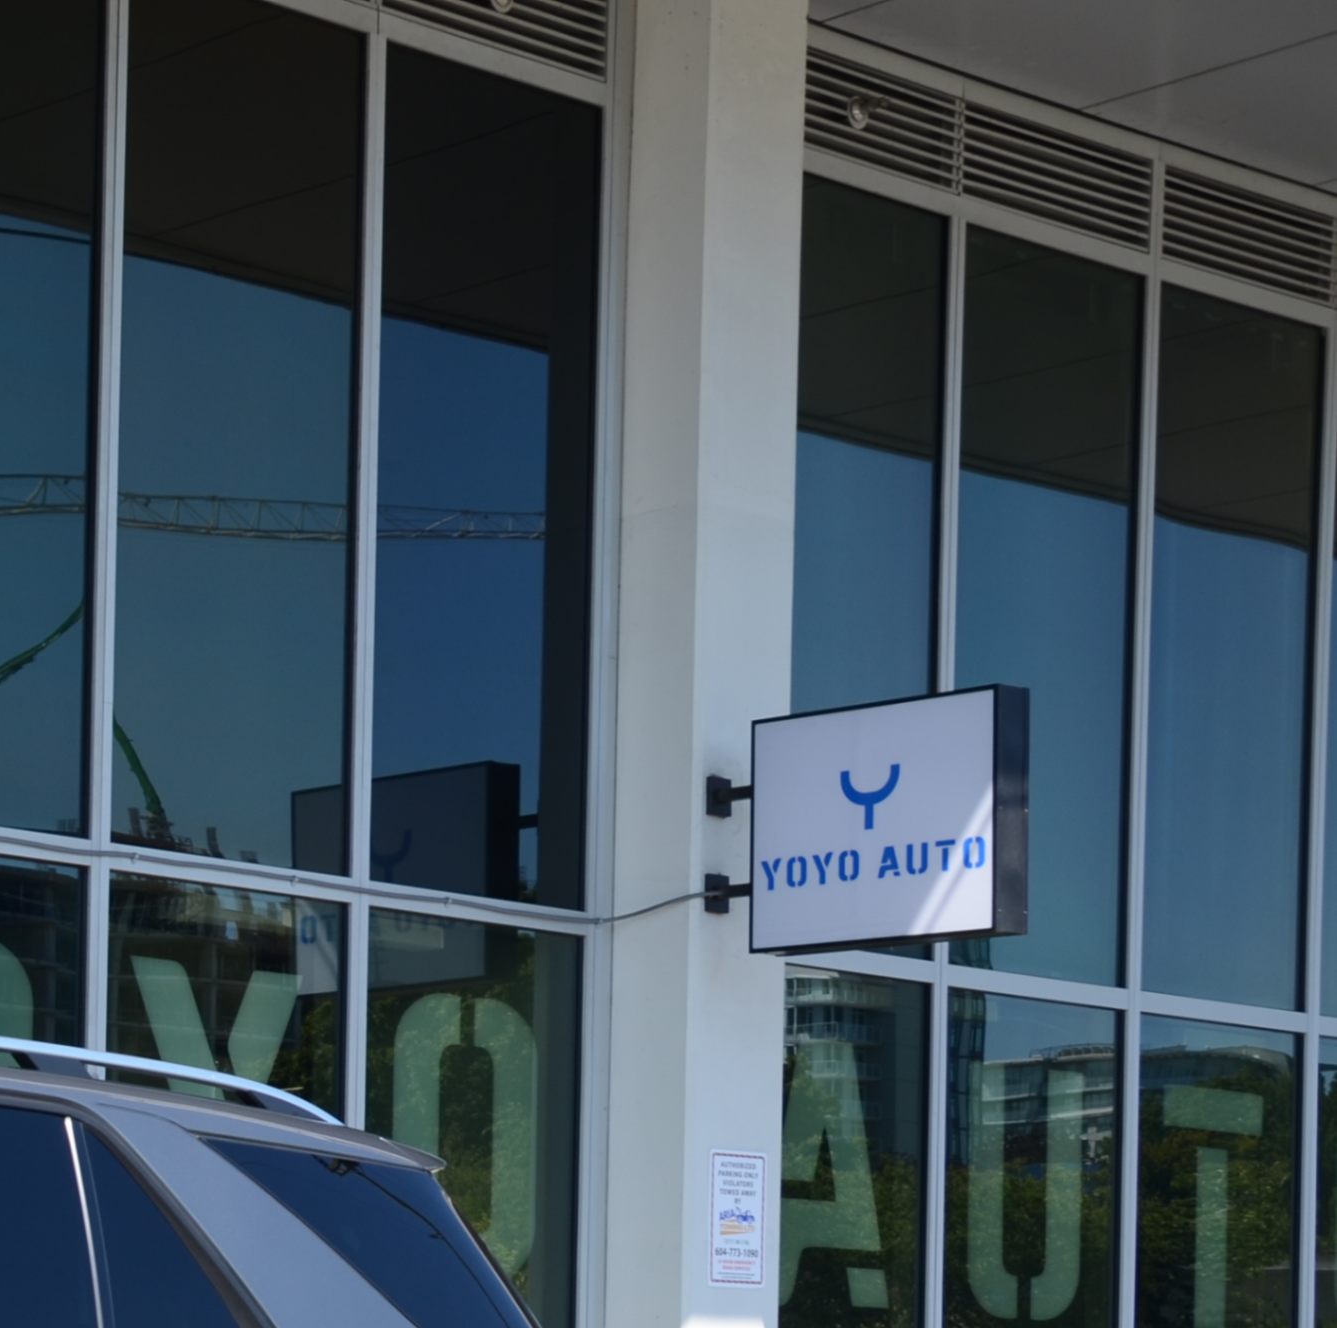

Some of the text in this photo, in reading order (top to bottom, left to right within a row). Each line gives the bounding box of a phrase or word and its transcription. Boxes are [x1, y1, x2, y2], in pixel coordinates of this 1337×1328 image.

[761, 836, 986, 891] YOYO AUTO
[718, 1170, 743, 1178] PARKING
